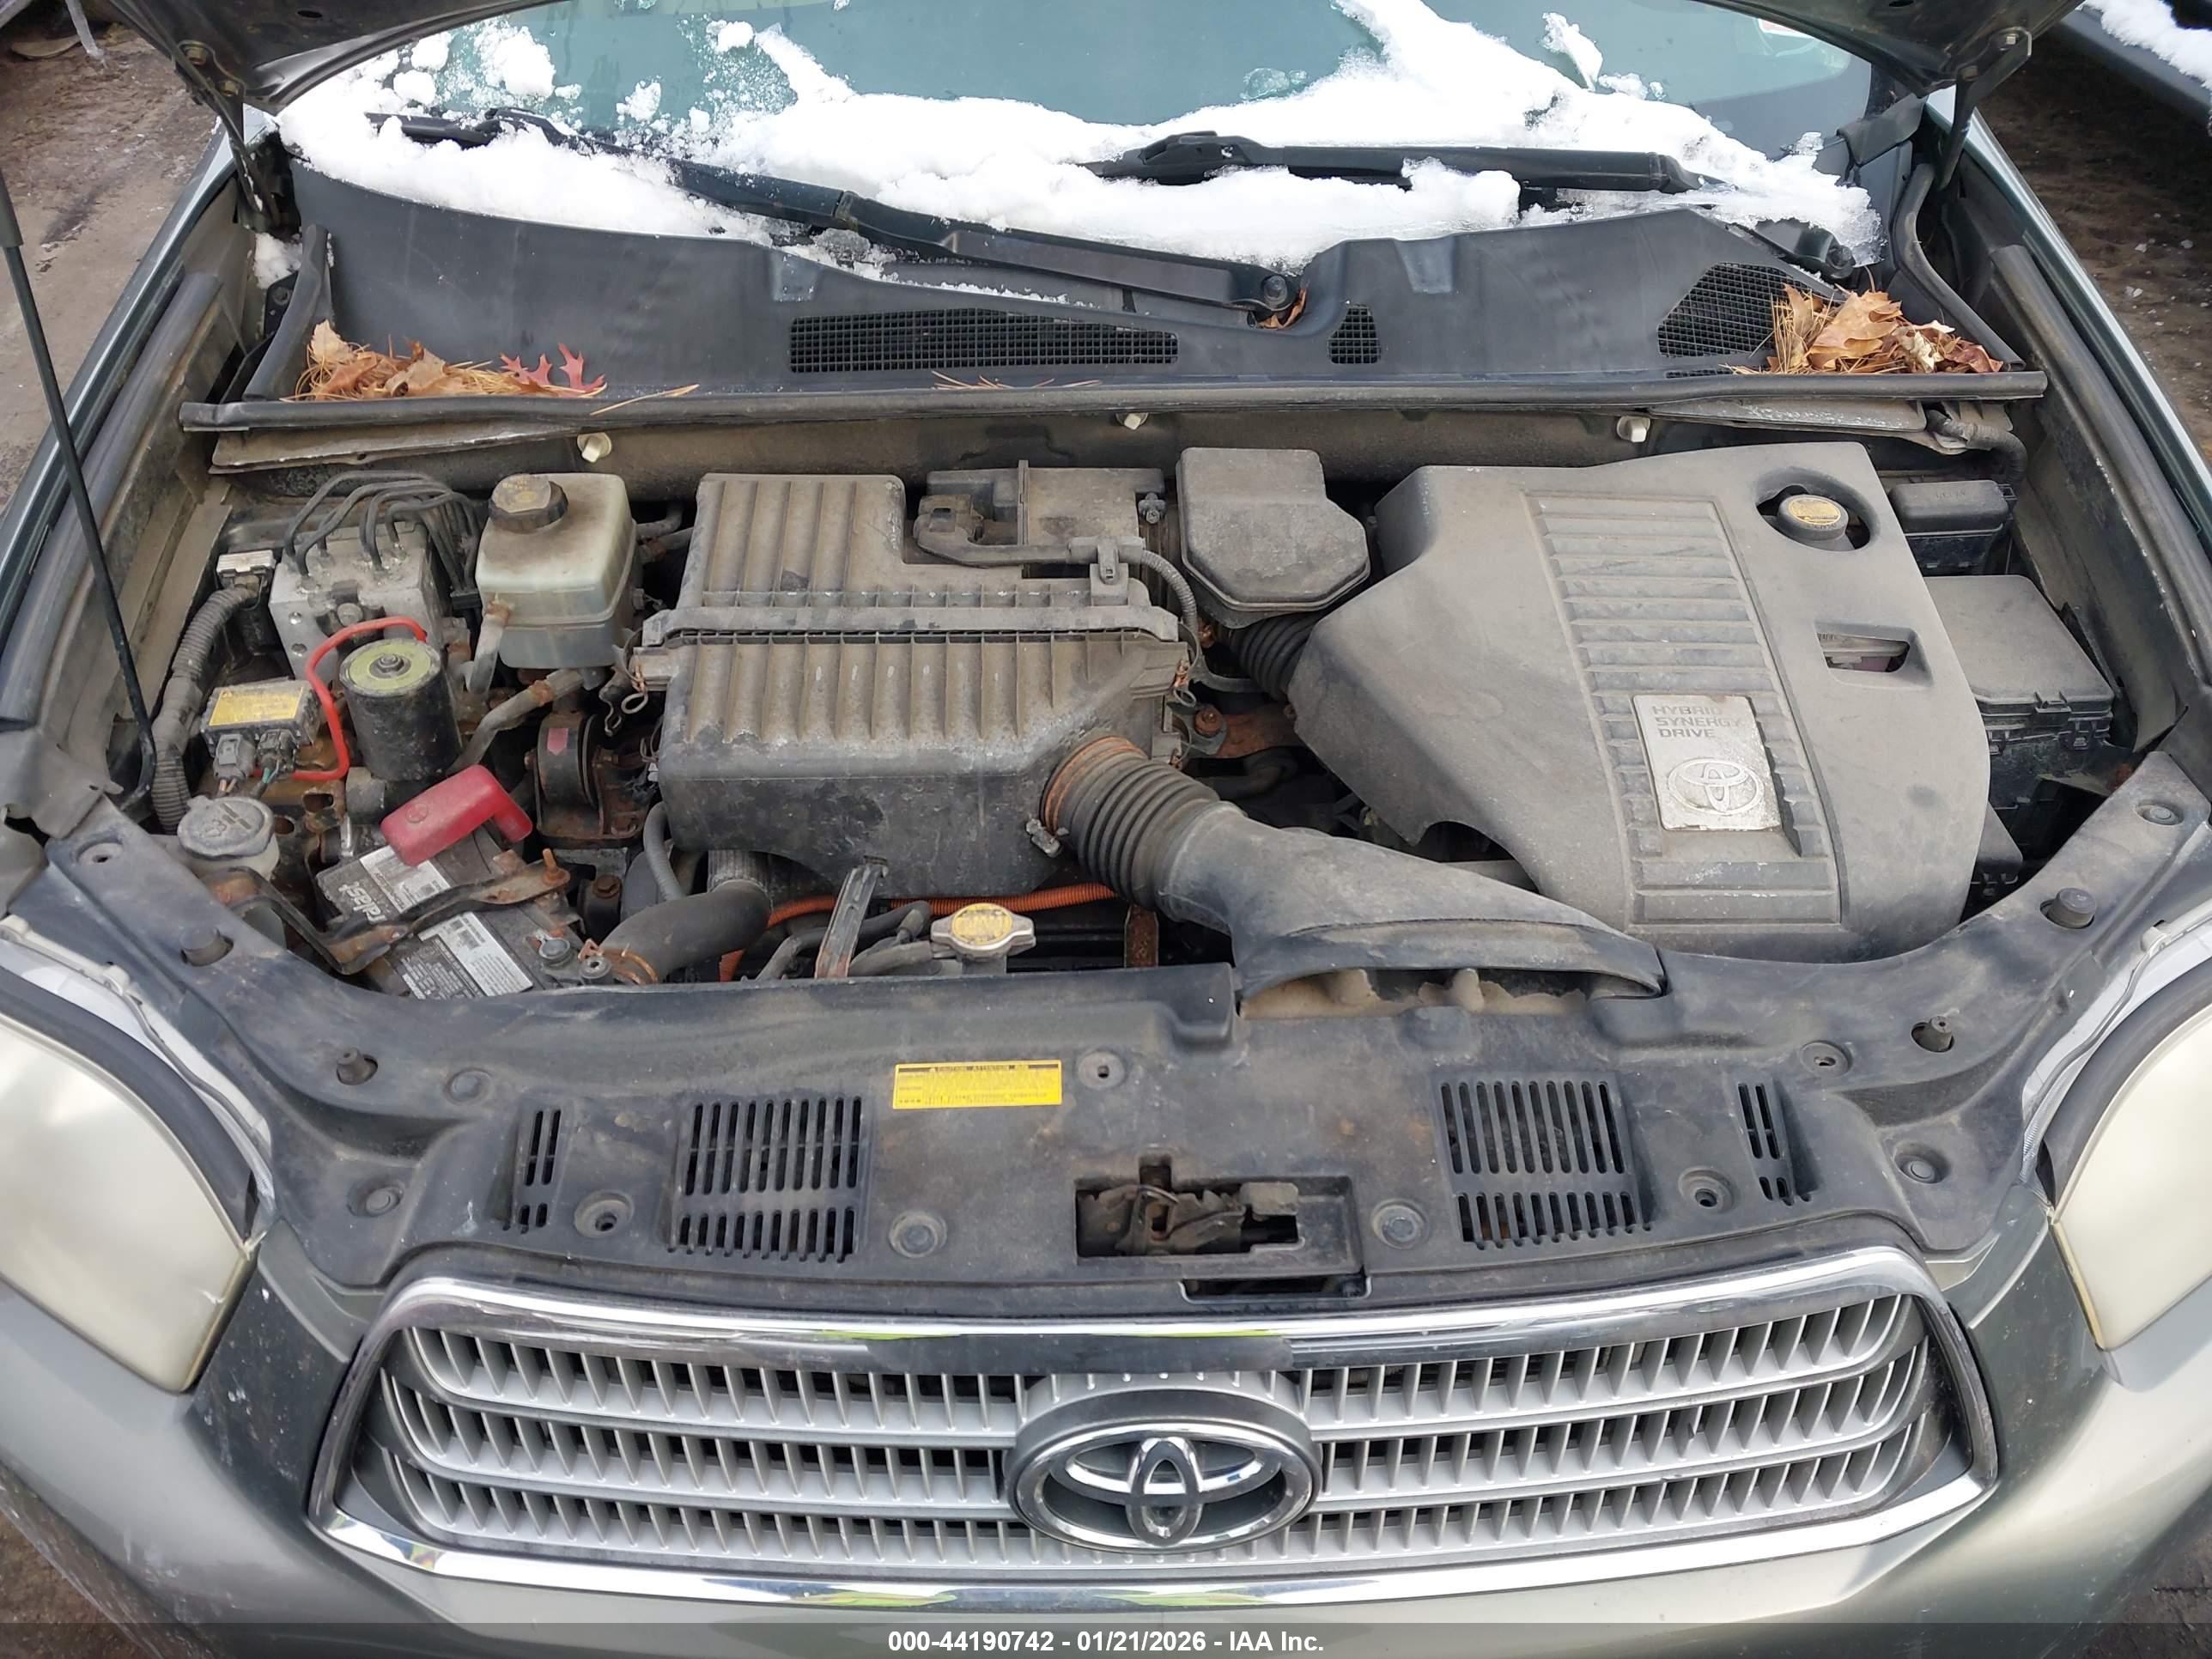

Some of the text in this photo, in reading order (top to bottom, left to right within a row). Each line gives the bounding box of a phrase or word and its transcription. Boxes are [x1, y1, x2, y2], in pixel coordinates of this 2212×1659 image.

[1651, 705, 1723, 715] HYBRID
[1654, 716, 1743, 727] SYNERGY
[1658, 728, 1717, 738] DRIVE
[337, 880, 386, 922] ralast
